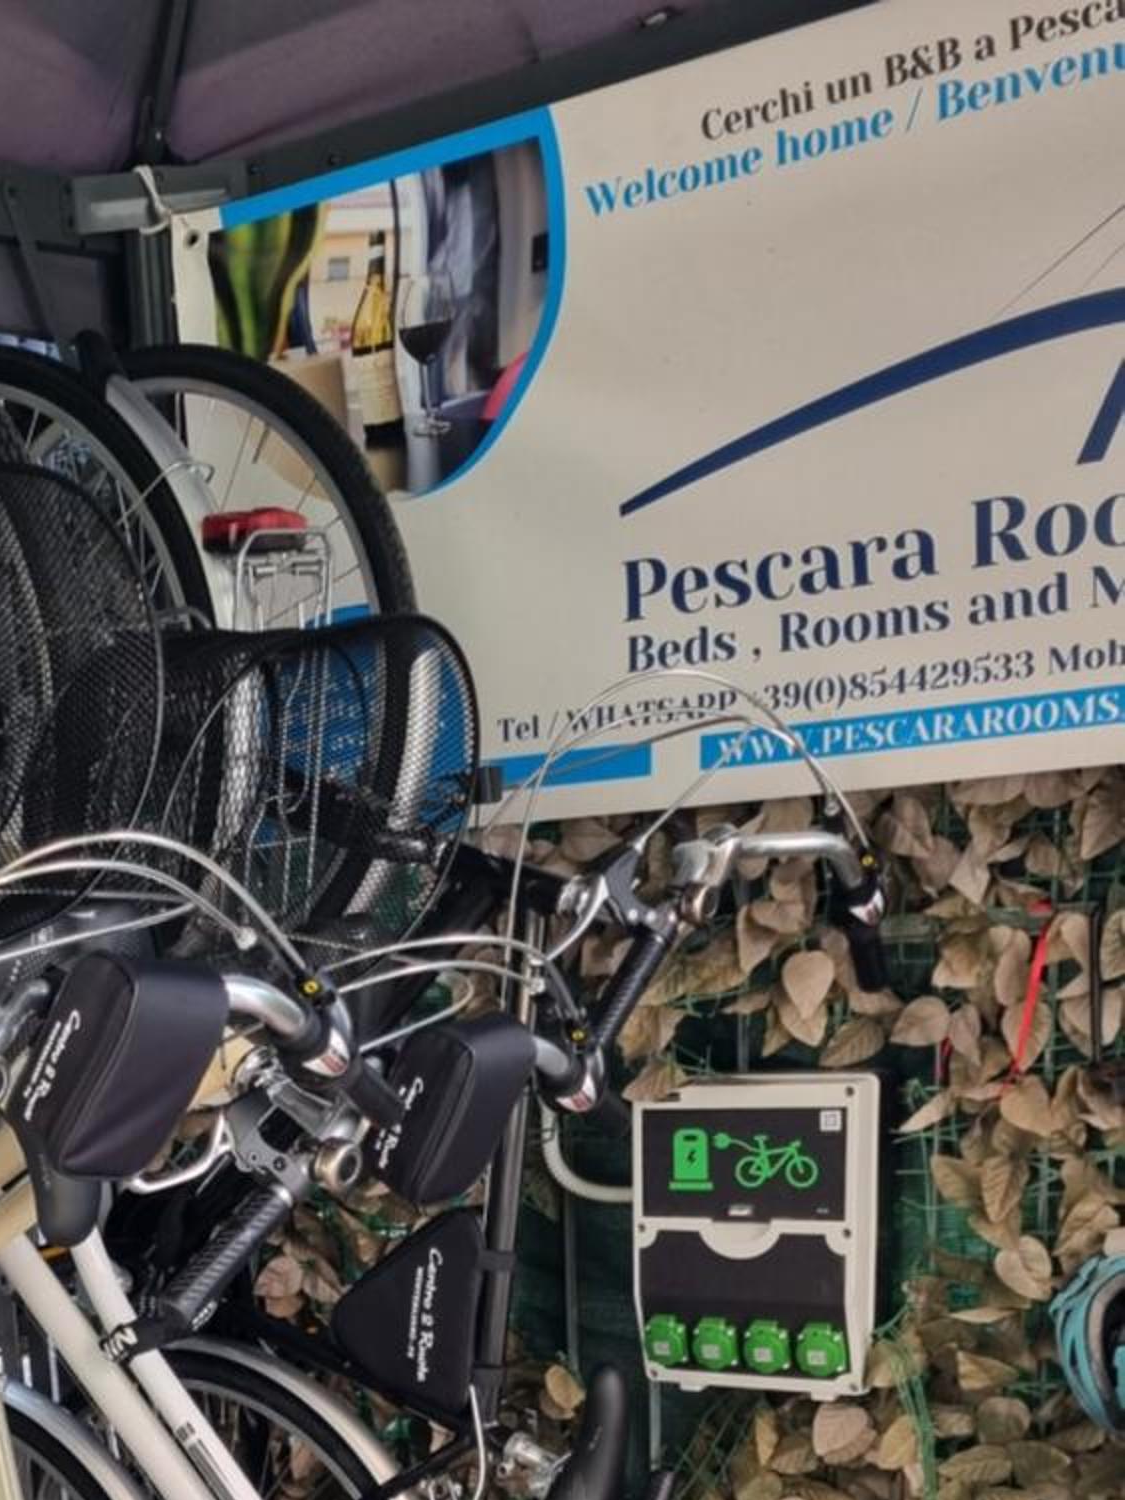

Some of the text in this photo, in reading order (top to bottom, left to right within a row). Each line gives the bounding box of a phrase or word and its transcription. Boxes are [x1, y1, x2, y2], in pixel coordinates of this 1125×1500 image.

[701, 80, 815, 142] Cerchi
[825, 70, 873, 106] un
[884, 37, 962, 88] B&B
[974, 34, 996, 62] a
[584, 136, 763, 217] Welcome
[776, 106, 893, 168] home
[905, 86, 924, 133] /
[621, 526, 939, 623] Pescara
[627, 627, 737, 674] Beds
[779, 600, 951, 653] Rooms
[968, 571, 1069, 626] and
[496, 713, 540, 743] Tel
[749, 650, 1035, 712] 39(0)854429533
[423, 1248, 444, 1310] Centro
